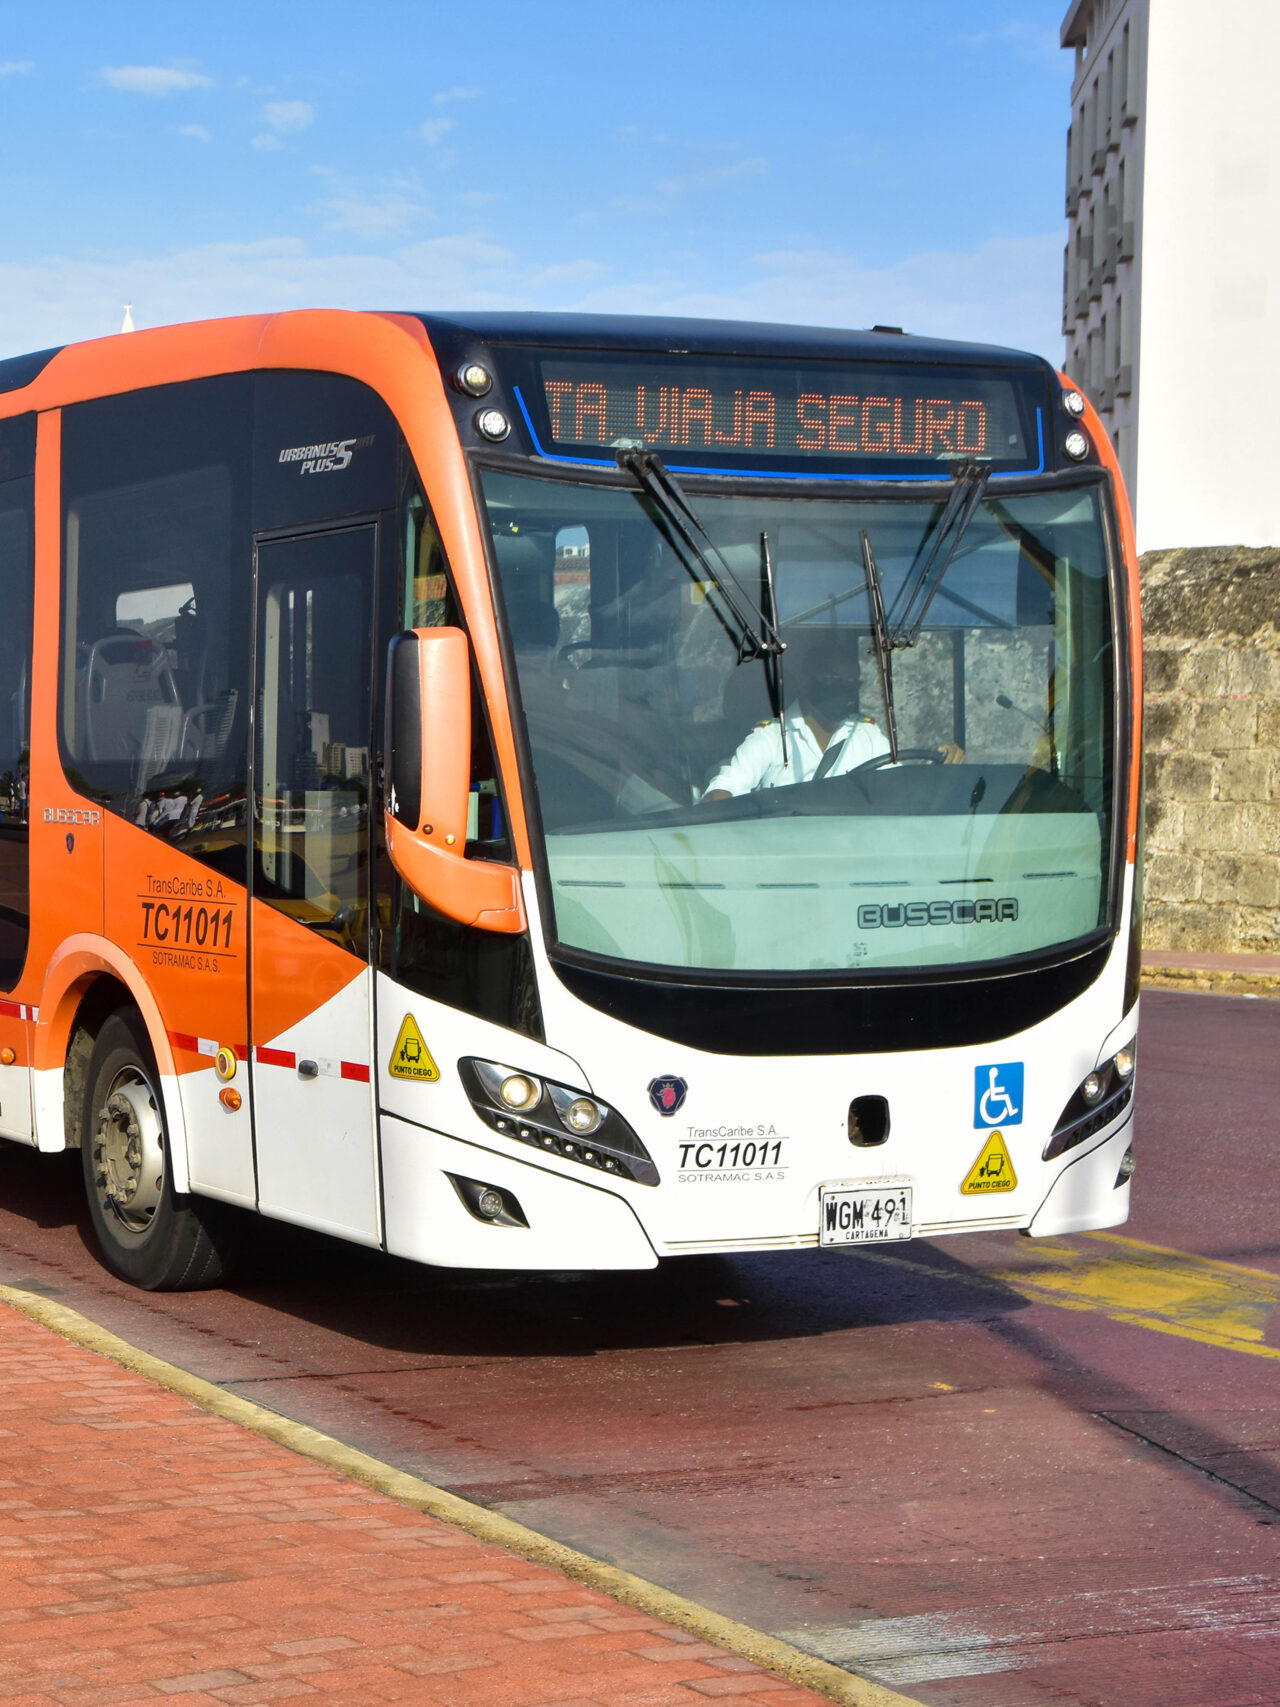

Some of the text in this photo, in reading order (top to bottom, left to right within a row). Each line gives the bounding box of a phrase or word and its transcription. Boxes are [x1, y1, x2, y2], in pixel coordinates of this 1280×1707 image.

[636, 385, 776, 448] VIAJA
[796, 393, 987, 455] SEGURO
[278, 441, 340, 463] URBANUS
[300, 457, 336, 475] PLUS
[43, 807, 100, 826] BUSSCAR
[146, 875, 227, 899] TransCaribe S.A.
[857, 897, 1019, 930] BUSSCAR
[141, 902, 233, 949] TC11011
[152, 950, 196, 970] SOTRAMAC
[394, 1065, 433, 1077] PUNTO CIEGO
[687, 1124, 779, 1138] TransCaribe S.A.
[678, 1140, 782, 1169] TC11011
[678, 1172, 751, 1183] SOTRAMAC
[968, 1179, 1011, 1190] PUNTO CIEGO
[826, 1197, 910, 1231] WGM 491
[845, 1229, 889, 1240] CARTAGENA
